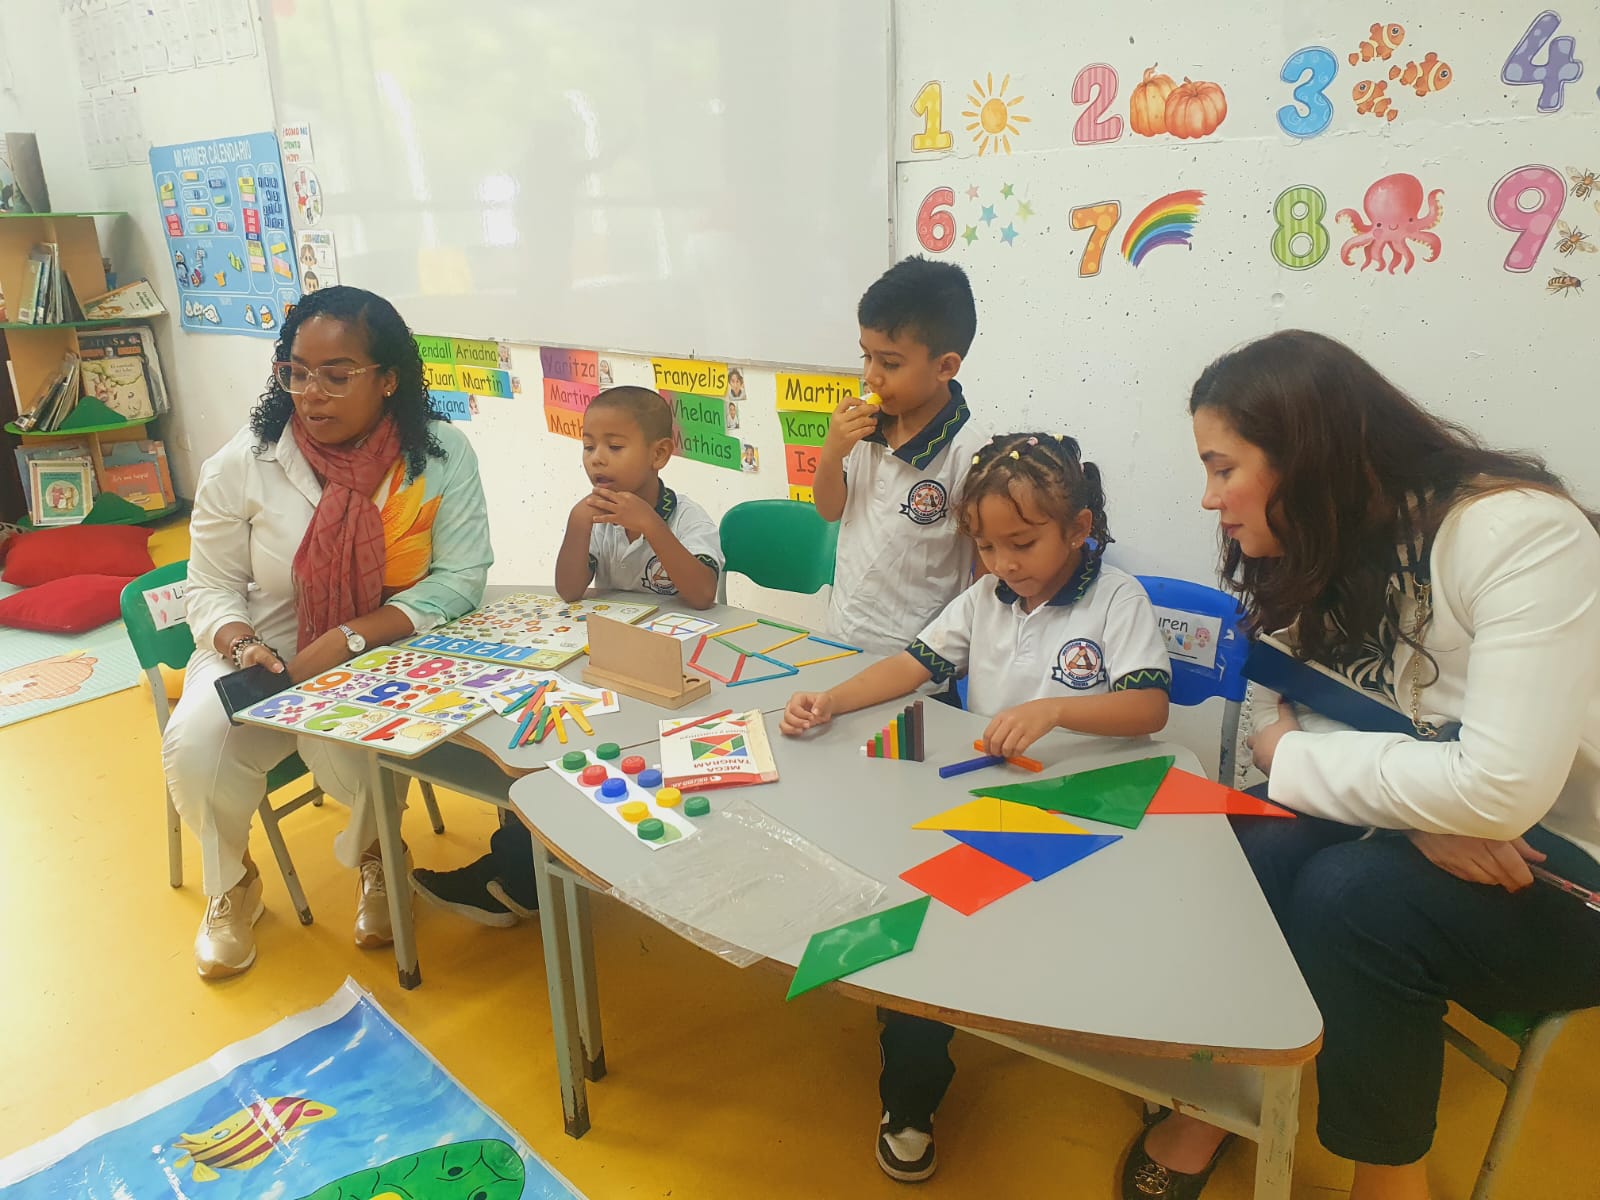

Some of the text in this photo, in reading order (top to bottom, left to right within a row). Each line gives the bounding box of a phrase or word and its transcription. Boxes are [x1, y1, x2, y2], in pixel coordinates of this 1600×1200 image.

[910, 9, 1584, 153] 1 2 3 4
[183, 146, 209, 166] PRIMER
[208, 140, 252, 164] CALENDARIO
[916, 164, 1568, 278] 6 7 8 9
[456, 344, 498, 362] Ariadna
[544, 354, 596, 378] Yaritza
[653, 363, 725, 393] Franyelis
[427, 368, 503, 393] Juan Martin
[785, 378, 852, 404] Martin
[550, 384, 596, 407] Martin
[693, 758, 752, 769] TANGRAM
[706, 765, 741, 773] MEGA
